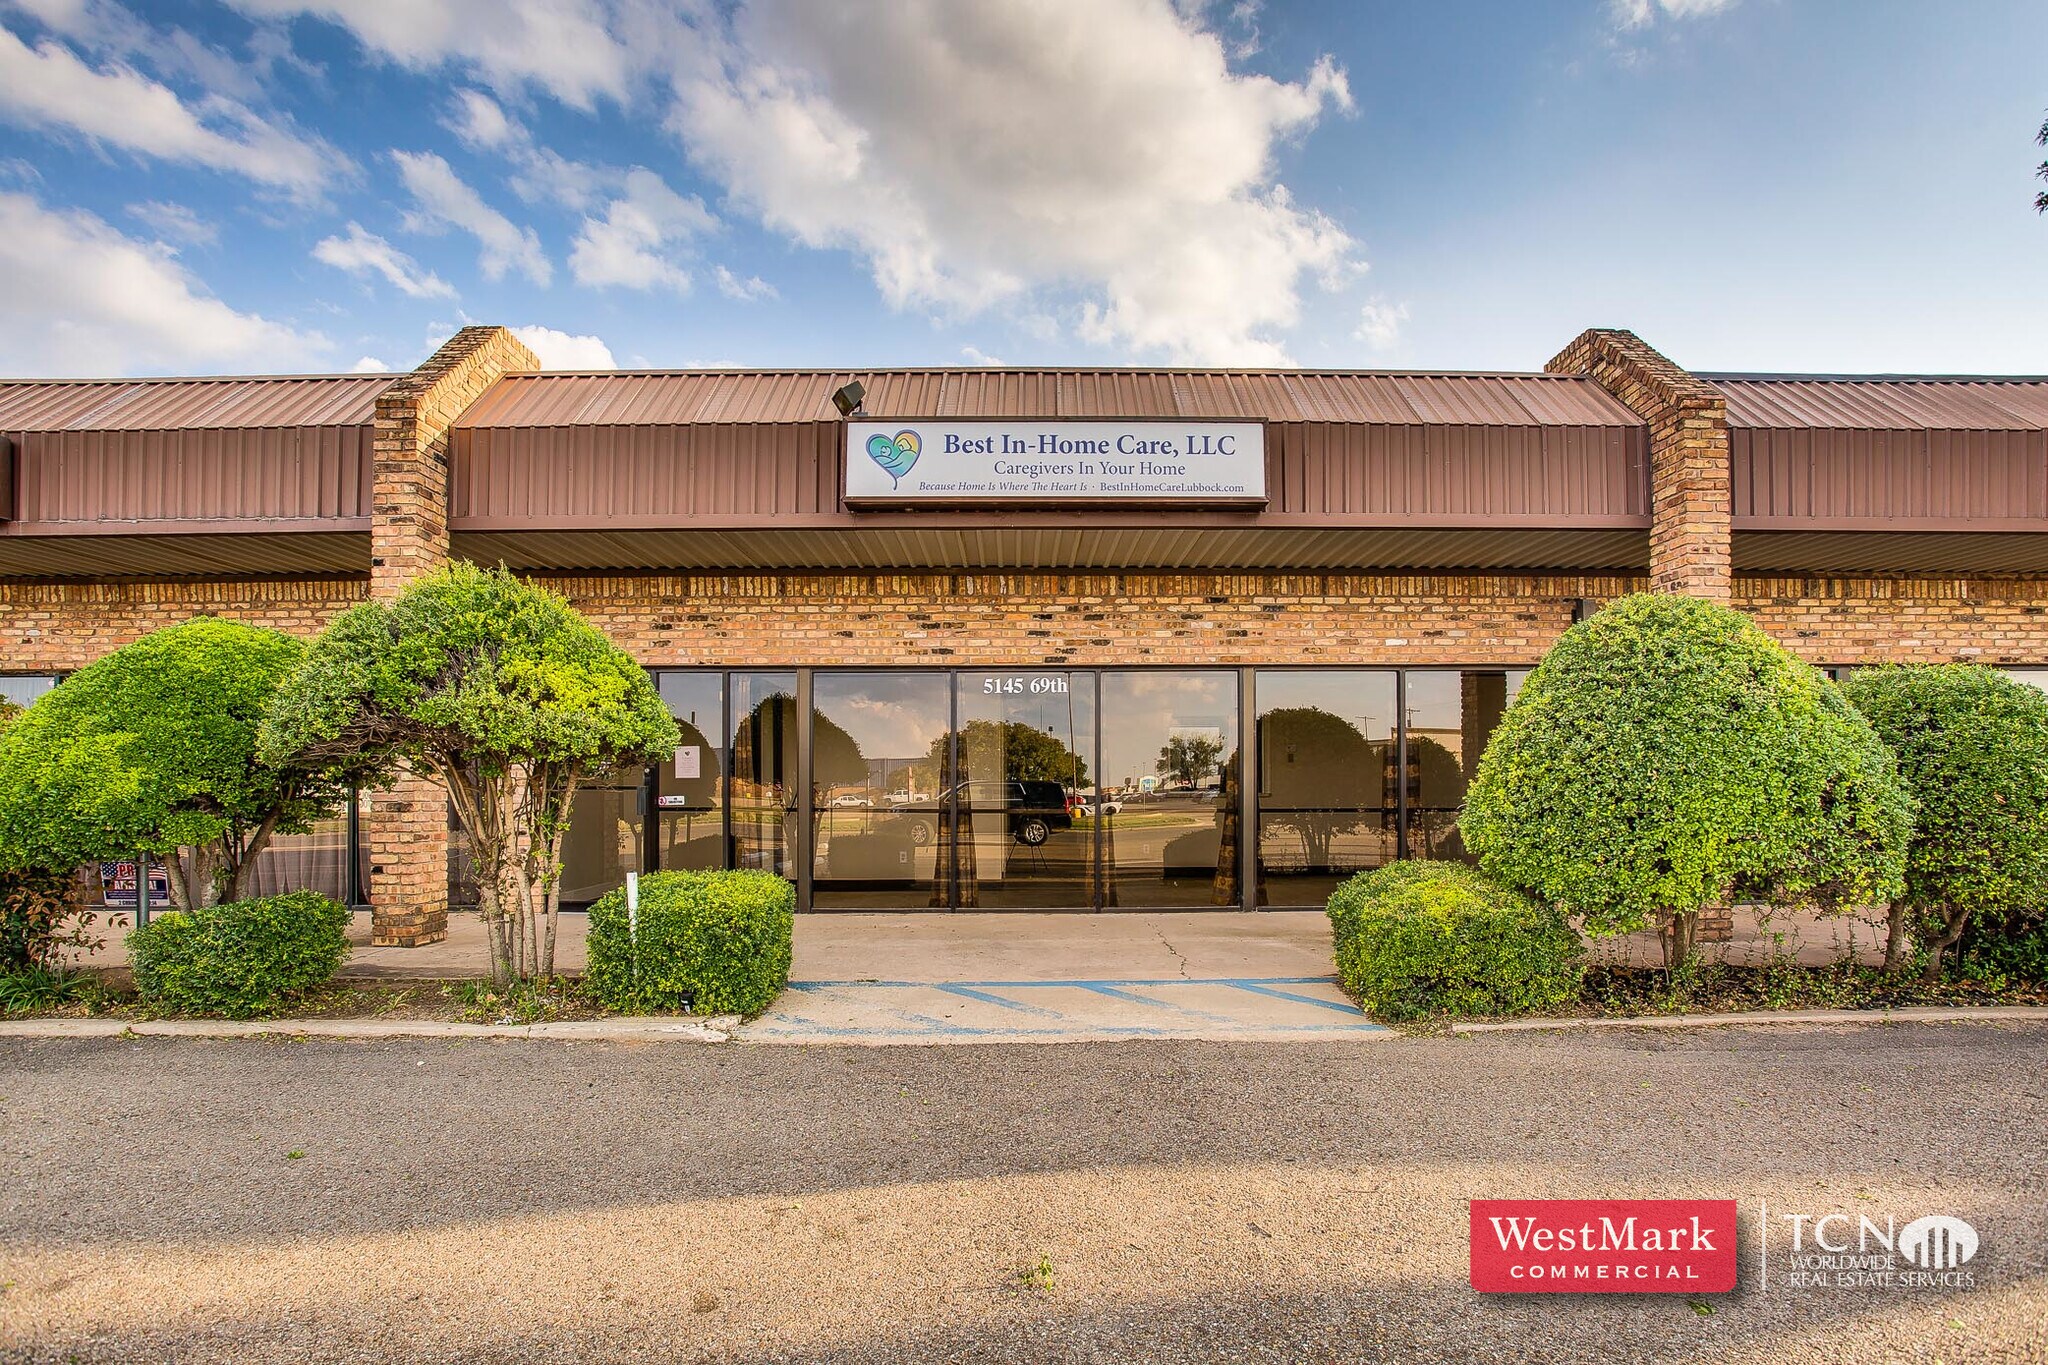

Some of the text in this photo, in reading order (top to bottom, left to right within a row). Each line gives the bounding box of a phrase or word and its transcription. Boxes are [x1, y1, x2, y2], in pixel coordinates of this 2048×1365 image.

[943, 434, 1236, 458] Best In-Home Care, LLC
[994, 461, 1186, 479] Caregivers In Your Home
[919, 481, 1245, 493] Because Home Is Where The Heart Is BestInHomeCareLubbock.com
[983, 677, 1069, 694] 5145 69th
